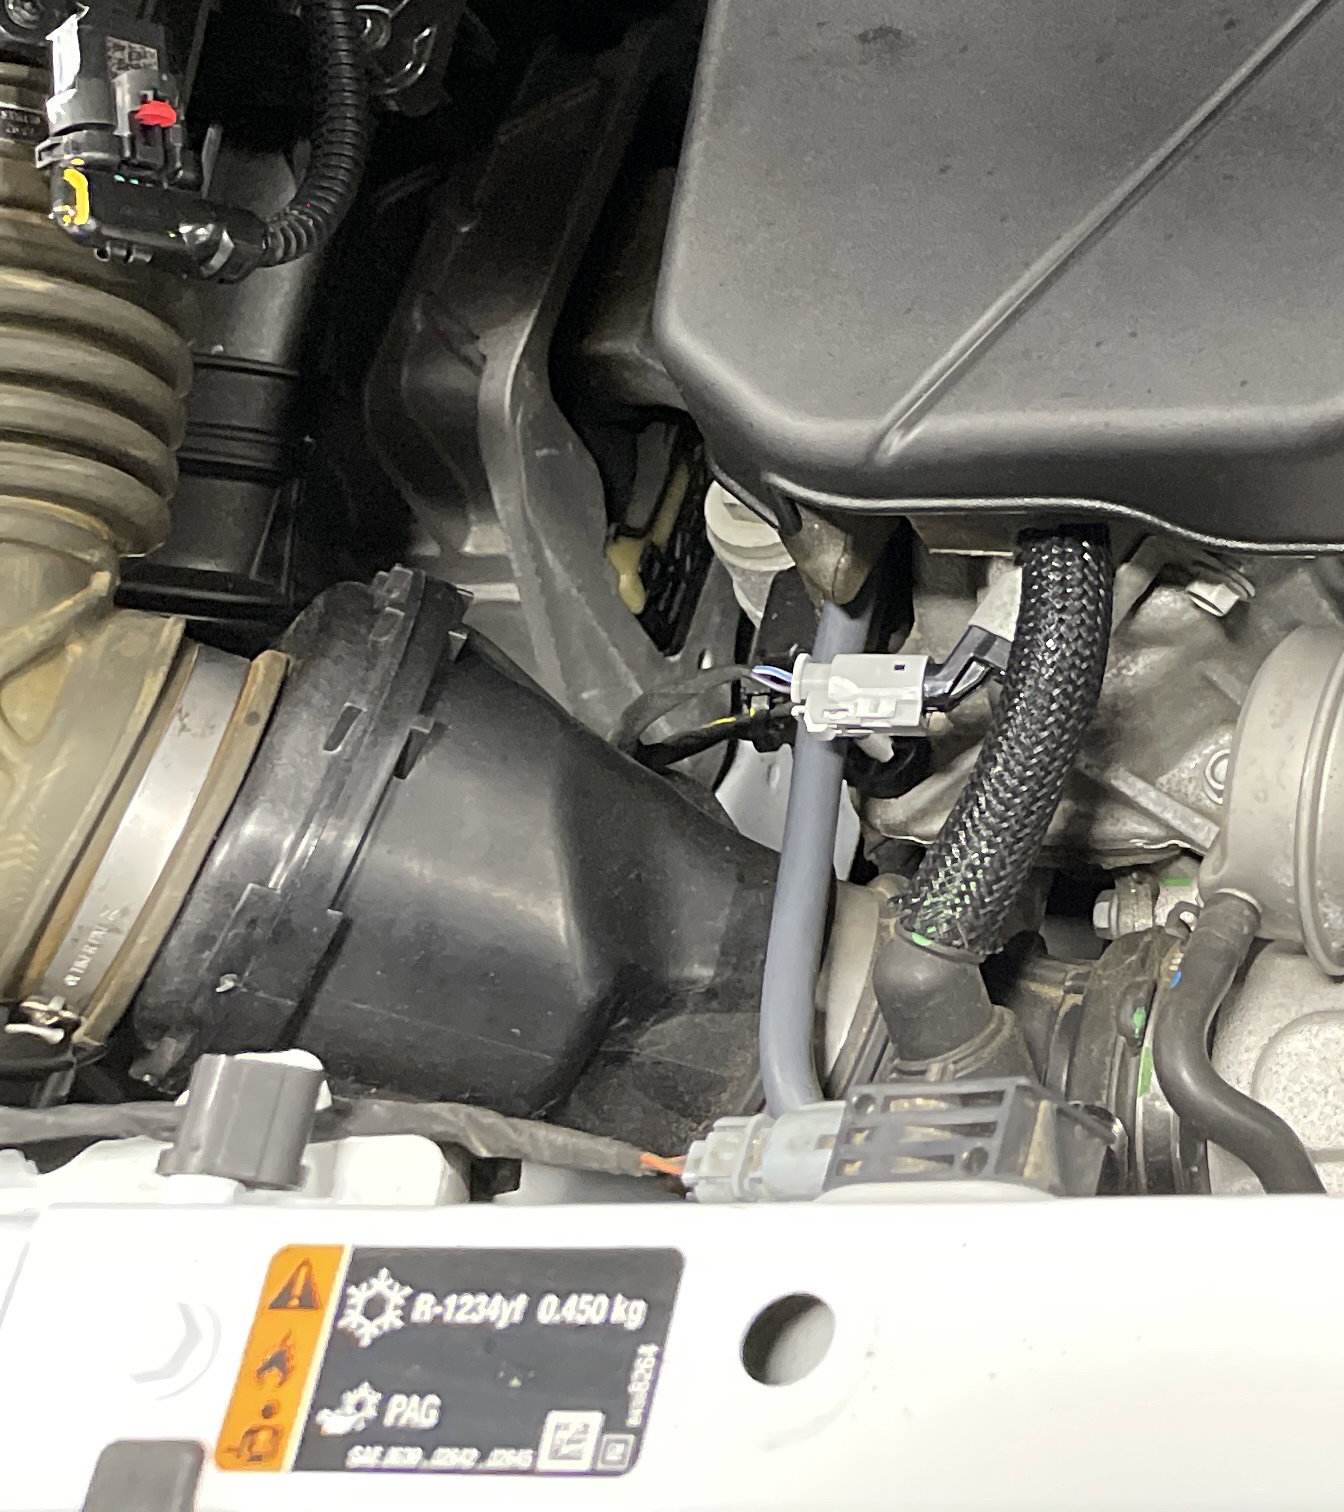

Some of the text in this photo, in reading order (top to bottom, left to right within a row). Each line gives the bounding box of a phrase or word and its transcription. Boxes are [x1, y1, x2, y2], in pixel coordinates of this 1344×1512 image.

[411, 1293, 648, 1330] R-1234yf 0.450 kg
[383, 1394, 442, 1429] PAG
